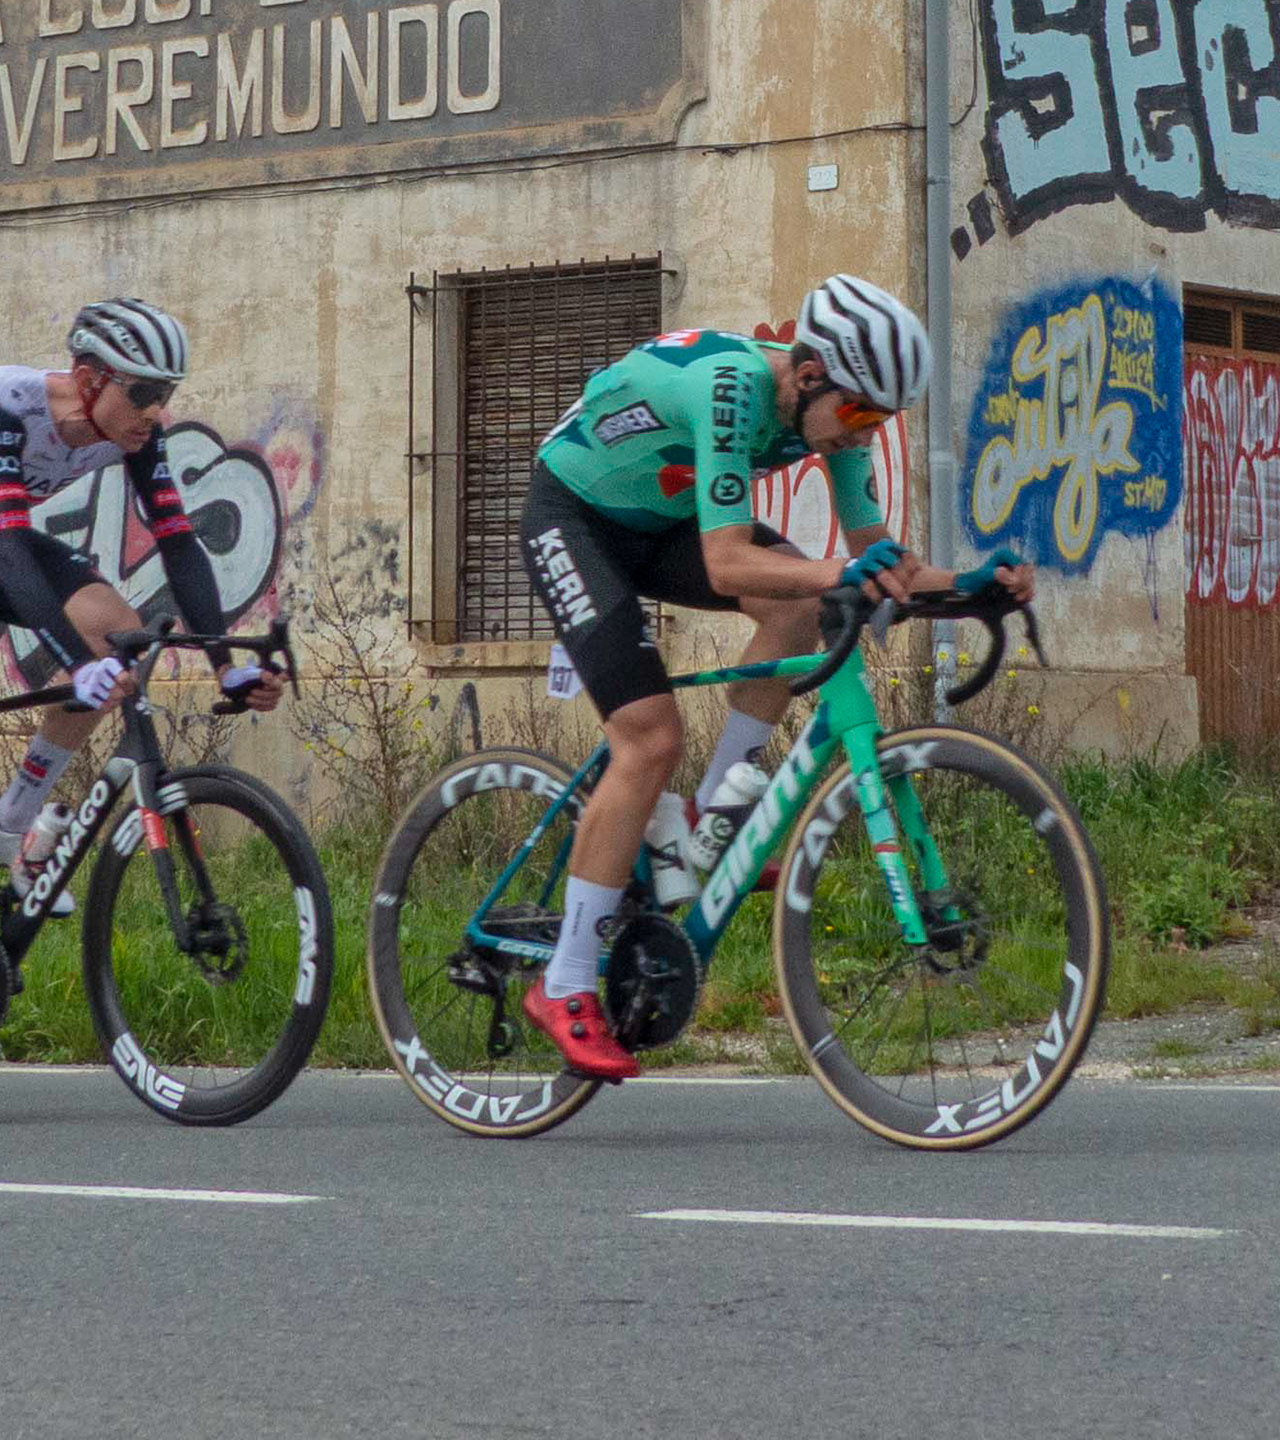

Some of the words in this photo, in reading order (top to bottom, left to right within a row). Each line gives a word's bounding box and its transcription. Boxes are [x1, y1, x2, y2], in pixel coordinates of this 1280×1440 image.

[713, 365, 738, 453] KERN
[537, 527, 597, 627] KERN
[23, 778, 109, 918] COLNAGO
[394, 1035, 553, 1123] CADEX
[923, 960, 1083, 1134] CADEX
